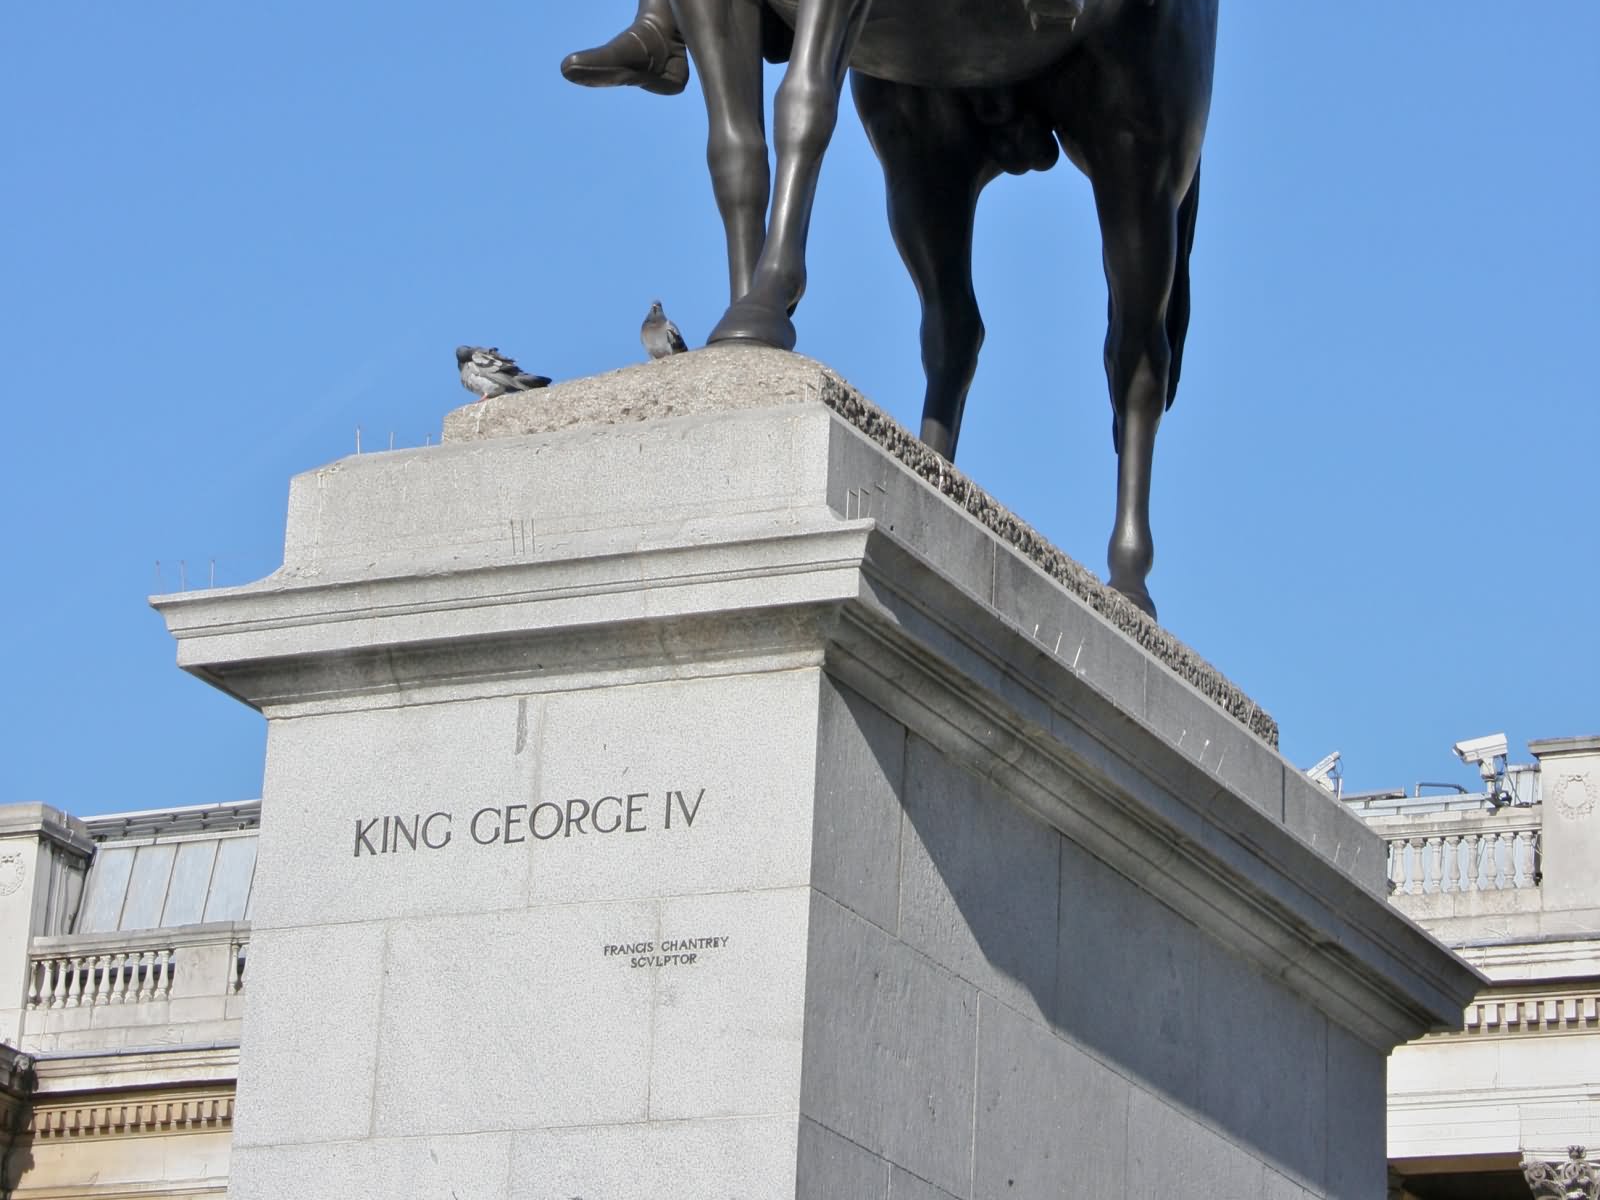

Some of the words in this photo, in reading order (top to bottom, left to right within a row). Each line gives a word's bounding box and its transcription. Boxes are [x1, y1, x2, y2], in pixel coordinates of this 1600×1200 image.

[353, 812, 452, 858] KING
[470, 793, 649, 845] GEORGE
[664, 788, 706, 830] IV
[603, 942, 654, 956] FRANCIS
[661, 936, 729, 952] CHANTREY
